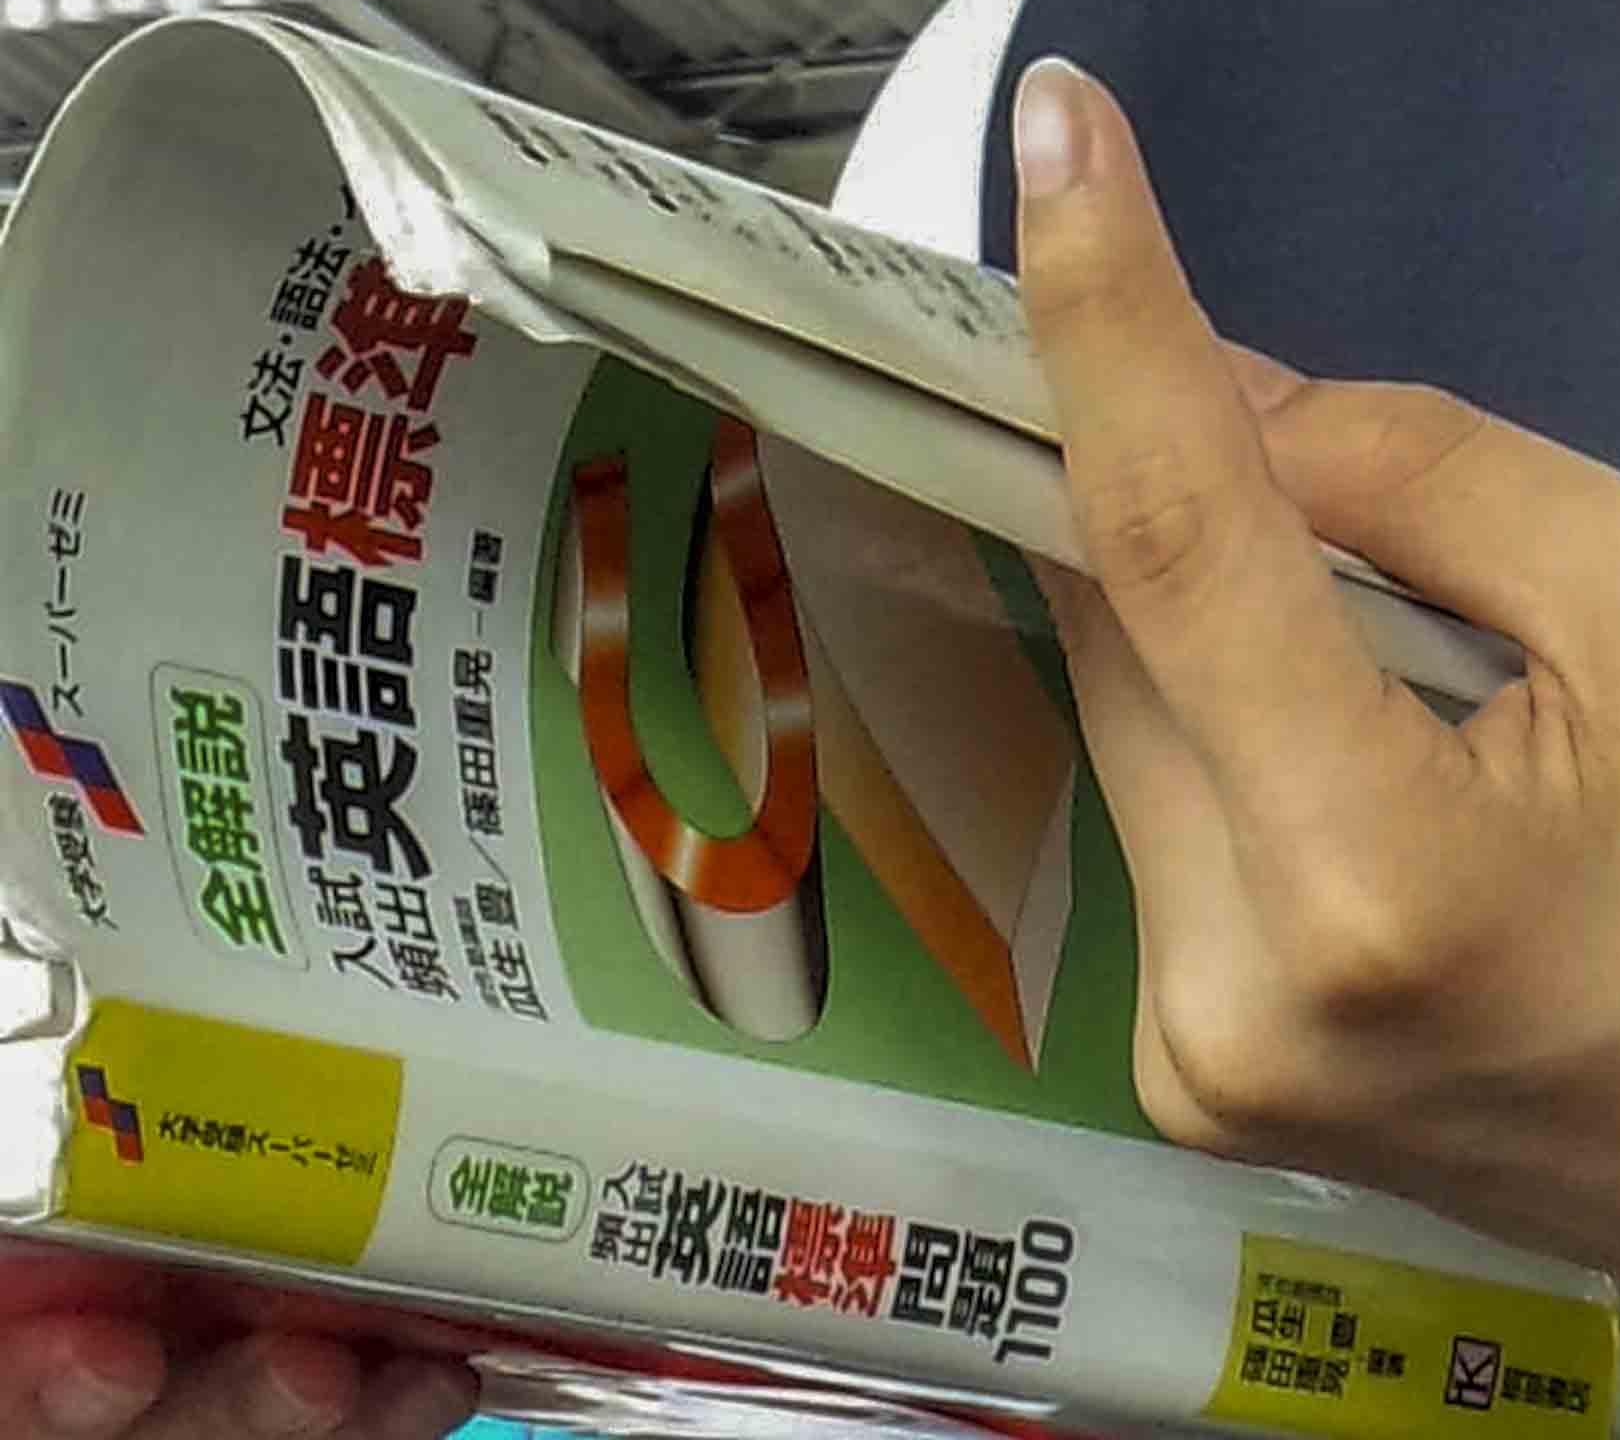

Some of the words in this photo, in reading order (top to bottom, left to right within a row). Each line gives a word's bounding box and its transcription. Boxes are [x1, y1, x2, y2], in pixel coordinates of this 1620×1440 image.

[240, 184, 357, 447] 文法・語法・
[44, 487, 86, 717] スーパーゼミ
[46, 792, 118, 930] 大学受験
[169, 686, 286, 956] 全解説
[306, 865, 397, 990] 入試
[375, 882, 461, 1002] 頻出
[448, 1154, 573, 1227] 全解説
[590, 1211, 661, 1266] 頻出
[603, 1160, 667, 1216] 入試
